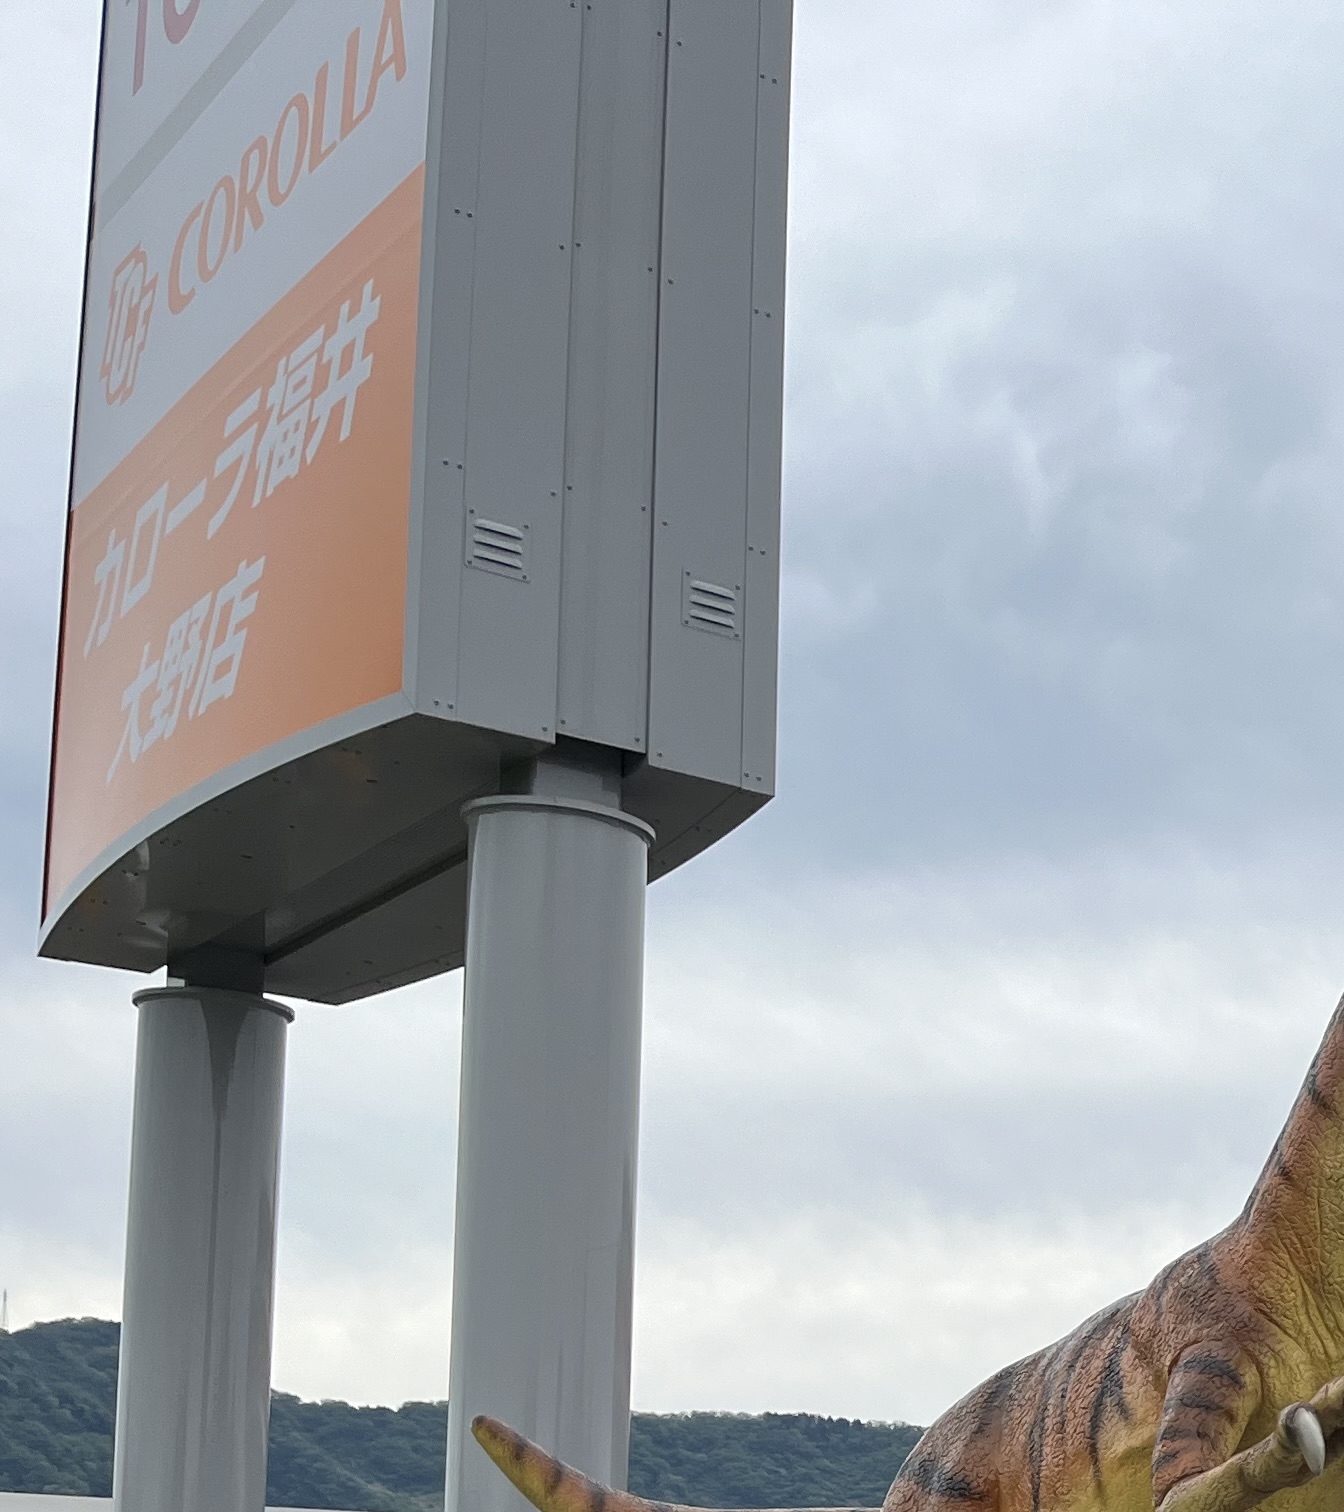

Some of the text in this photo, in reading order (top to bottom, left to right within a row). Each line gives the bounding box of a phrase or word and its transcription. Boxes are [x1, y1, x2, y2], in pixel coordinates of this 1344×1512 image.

[167, 0, 407, 315] COROLLA
[84, 278, 381, 660] カローラ福井
[106, 555, 266, 785] 大野店
